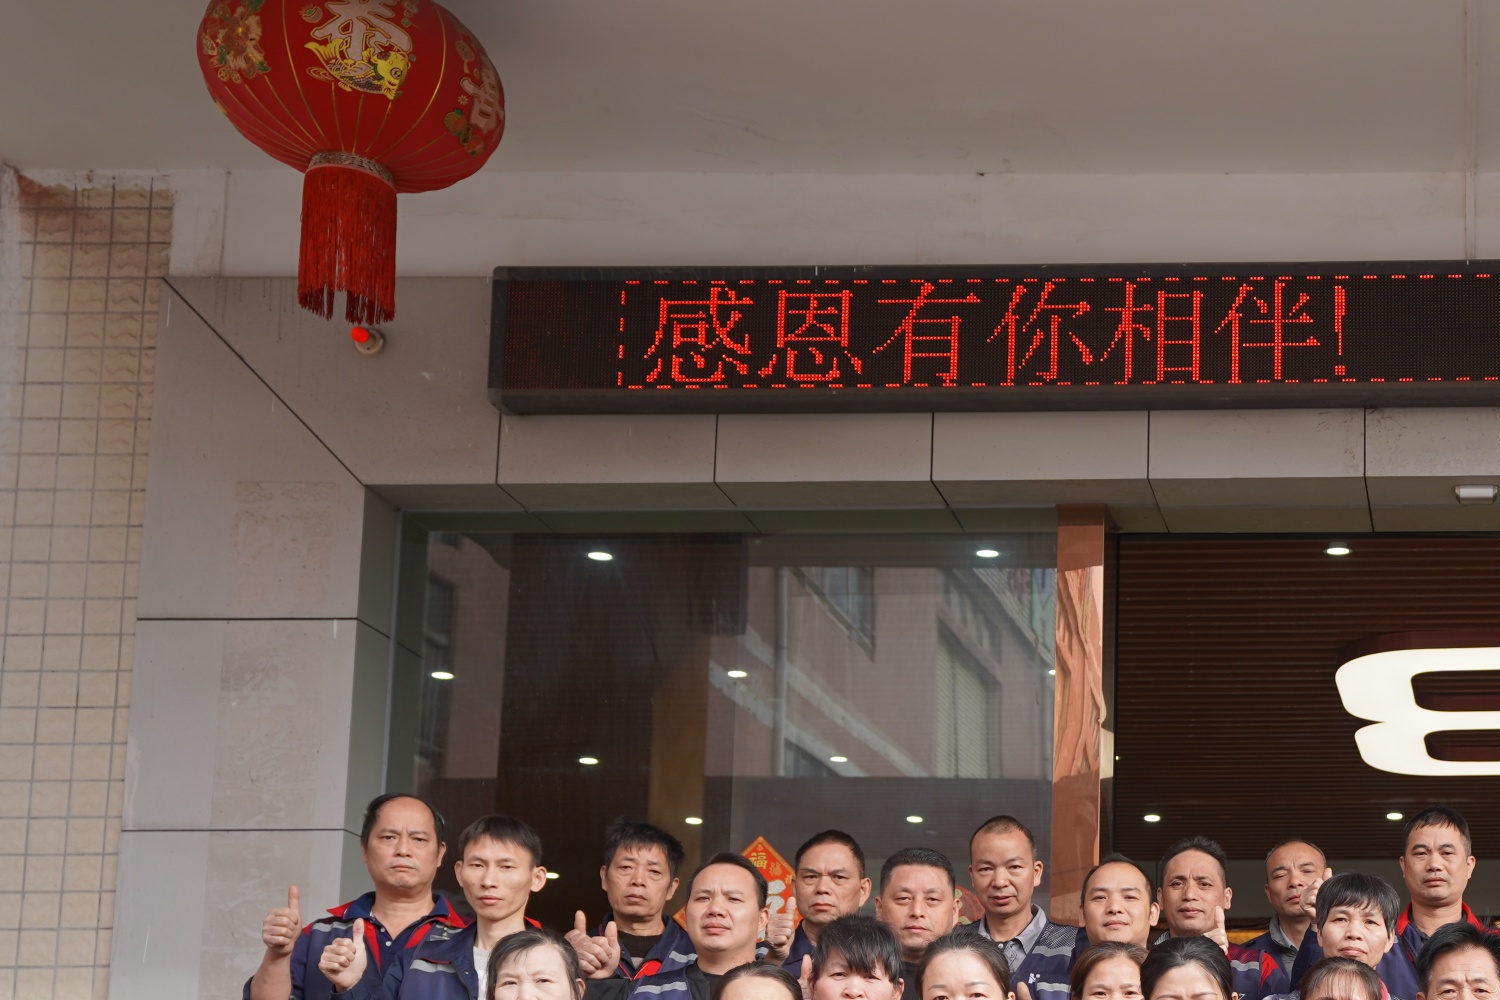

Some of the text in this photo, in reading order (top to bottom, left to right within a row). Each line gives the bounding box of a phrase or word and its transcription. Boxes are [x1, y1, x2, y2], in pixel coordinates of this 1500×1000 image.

[645, 282, 1347, 386] 感恩有你相伴!
[749, 852, 767, 869] 福
